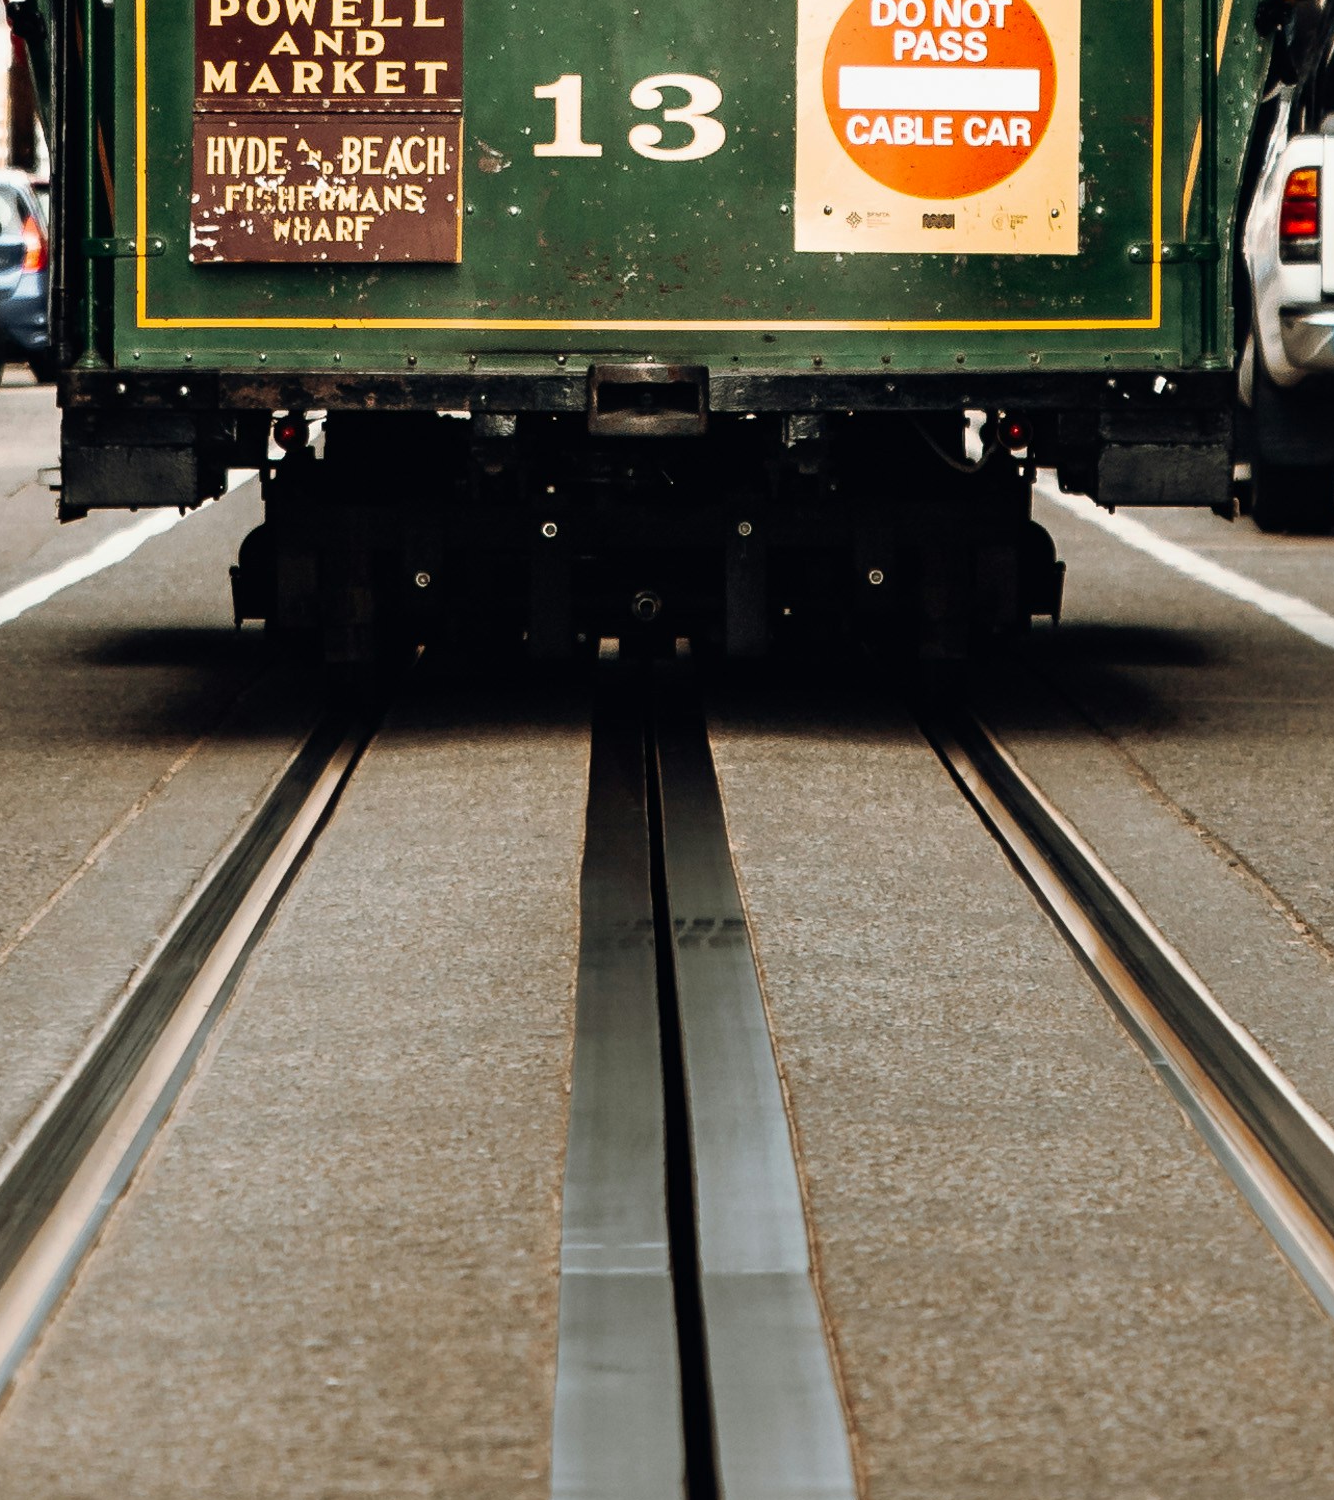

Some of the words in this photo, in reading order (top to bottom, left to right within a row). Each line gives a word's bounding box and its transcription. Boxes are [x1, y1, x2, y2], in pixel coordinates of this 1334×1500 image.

[269, 30, 385, 56] AND
[893, 29, 988, 62] PASS
[203, 60, 448, 94] MARKET
[533, 74, 726, 161] 13
[846, 115, 954, 146] CABLE
[963, 116, 1032, 147] CAR
[206, 136, 288, 175] HYDE
[296, 137, 334, 175] AND
[341, 136, 446, 175] BEACH
[224, 184, 425, 212] FISHERMANS
[273, 216, 375, 242] WHARF
